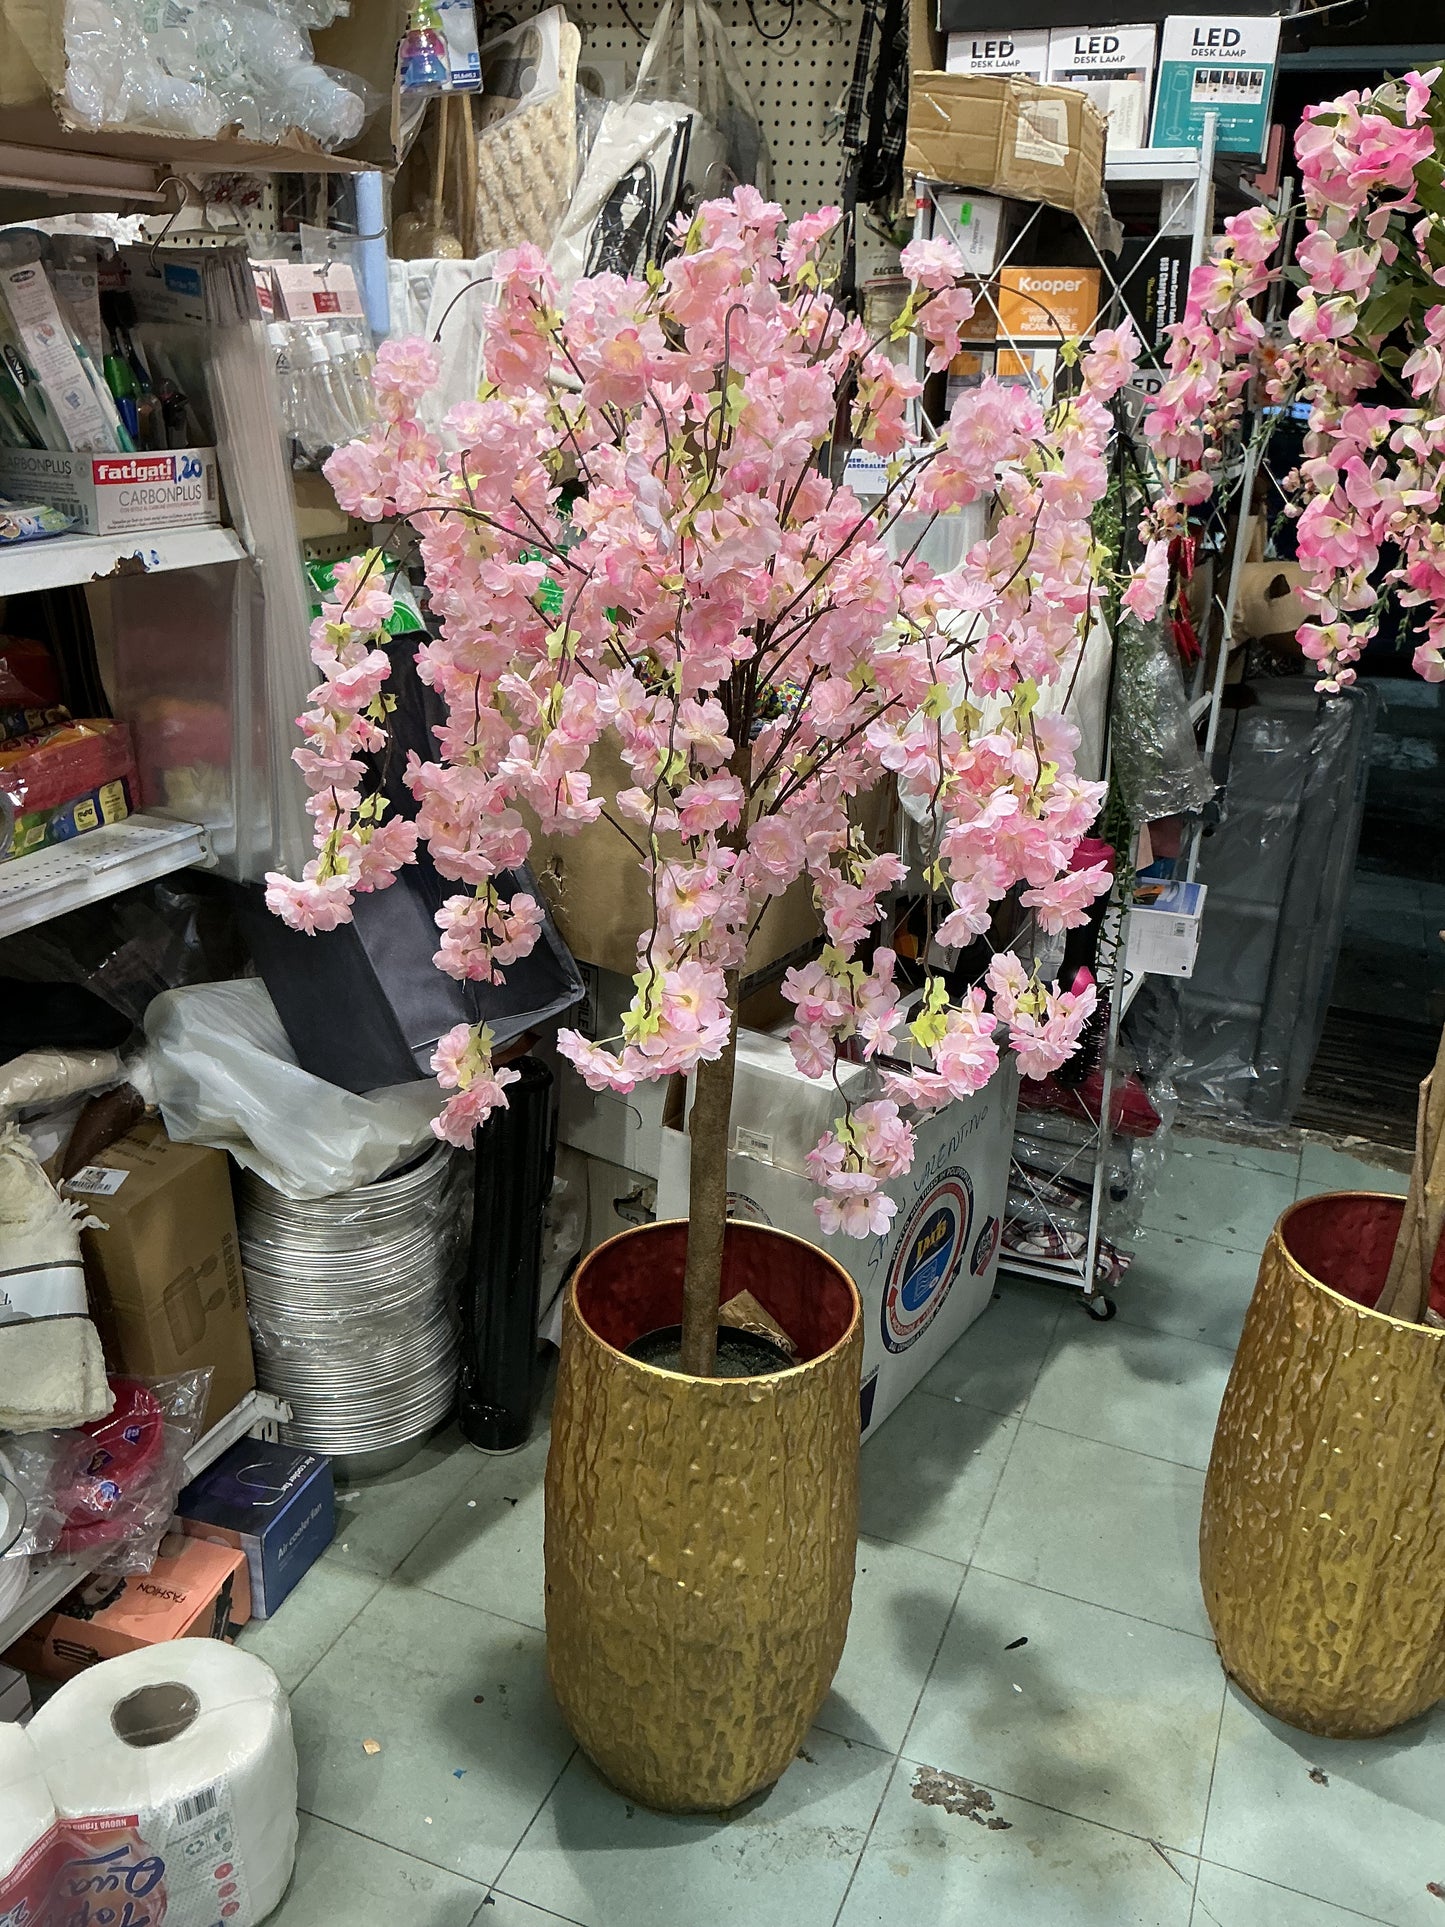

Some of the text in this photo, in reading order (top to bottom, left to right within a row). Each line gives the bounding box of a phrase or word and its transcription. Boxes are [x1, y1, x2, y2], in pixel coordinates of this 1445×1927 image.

[1074, 36, 1120, 55] LED
[1192, 27, 1241, 47] LED
[971, 40, 1015, 59] LED
[1191, 48, 1247, 57] DESK LAMP
[970, 59, 1021, 68] DESK LAMP
[1073, 55, 1126, 64] DESK LAMP
[1018, 276, 1082, 295] Kooper
[1132, 378, 1162, 395] ED
[98, 458, 172, 482] fatigati
[118, 484, 202, 507] CARBONPLUS
[913, 1105, 989, 1192] VALENTINO
[305, 1455, 316, 1464] Air
[289, 1464, 307, 1483] cooler
[277, 1503, 323, 1561] Air cooler fan
[136, 1582, 187, 1604] FASHION
[99, 1818, 127, 1831] NUOVA
